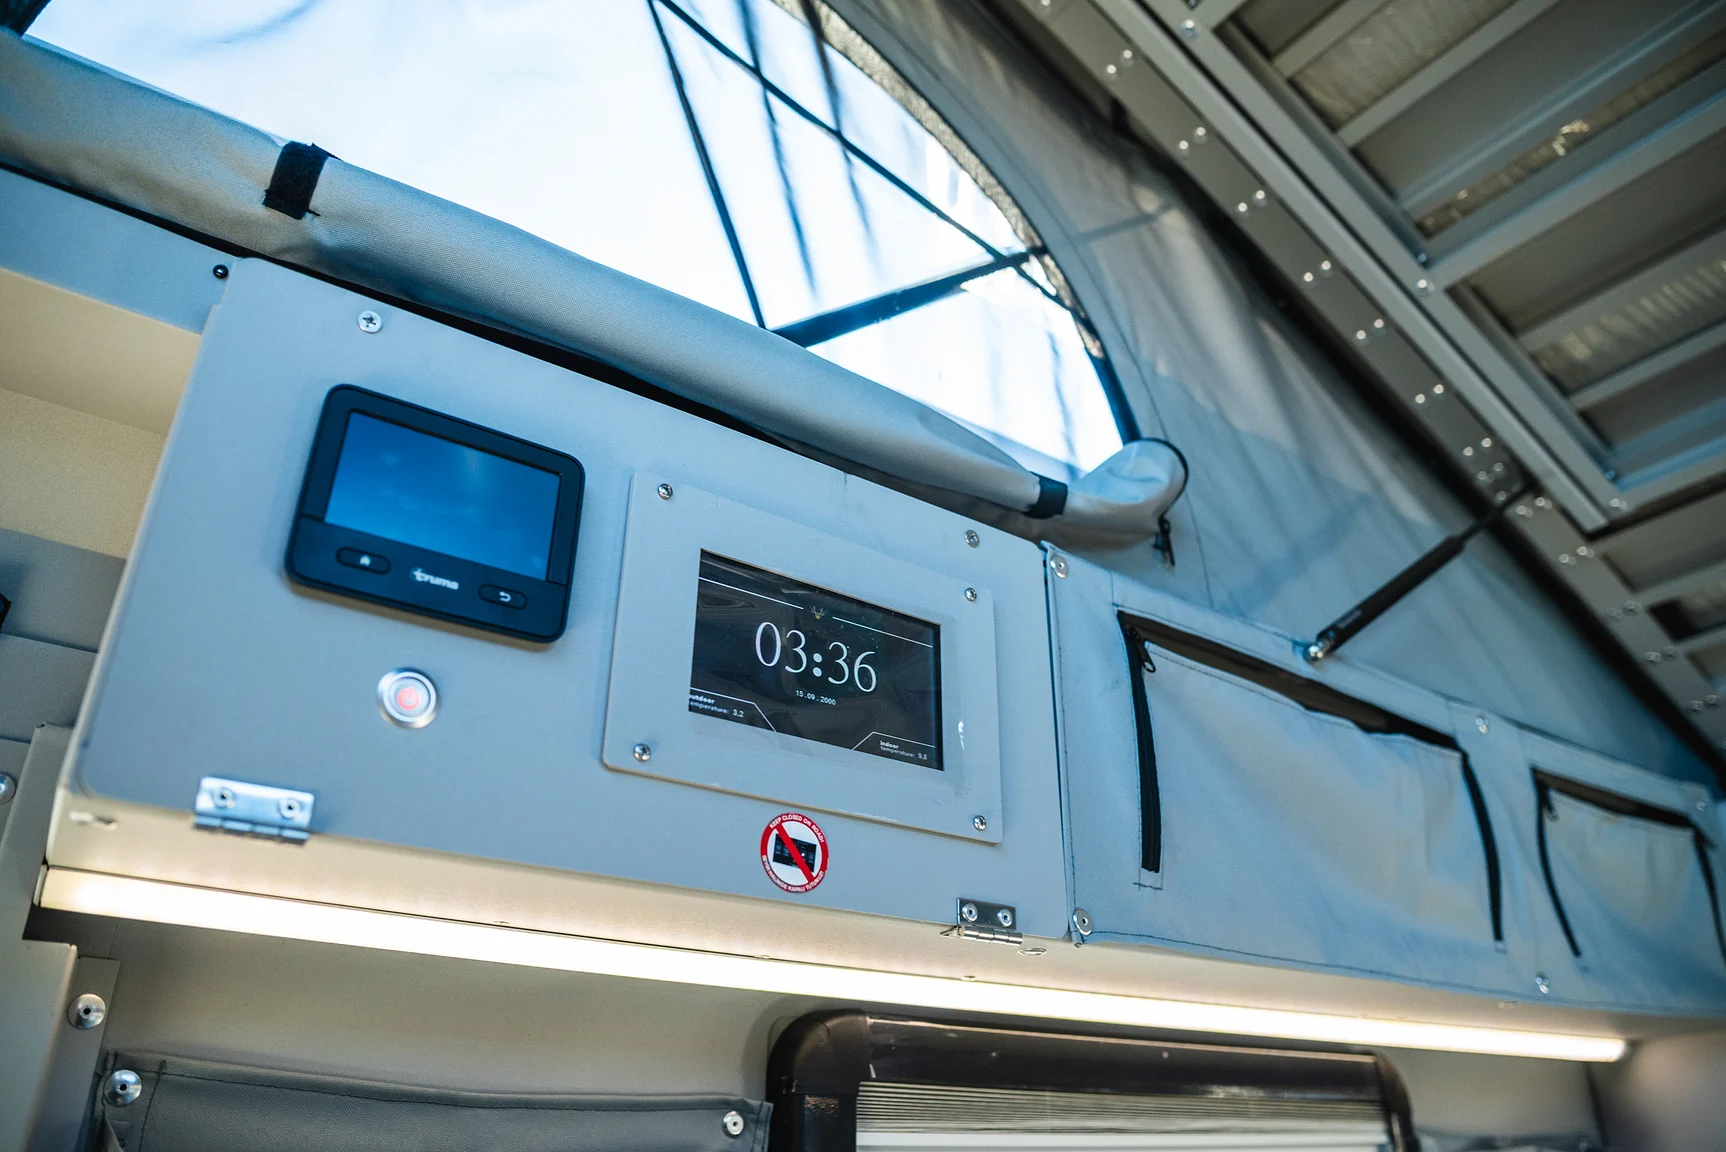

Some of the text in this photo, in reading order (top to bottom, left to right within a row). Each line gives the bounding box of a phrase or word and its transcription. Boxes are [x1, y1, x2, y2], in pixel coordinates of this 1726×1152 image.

[412, 568, 459, 590] truma
[755, 621, 877, 692] 03:36
[690, 701, 745, 718] emperature: 3.2
[769, 816, 782, 829] KEEP
[803, 818, 812, 827] ON
